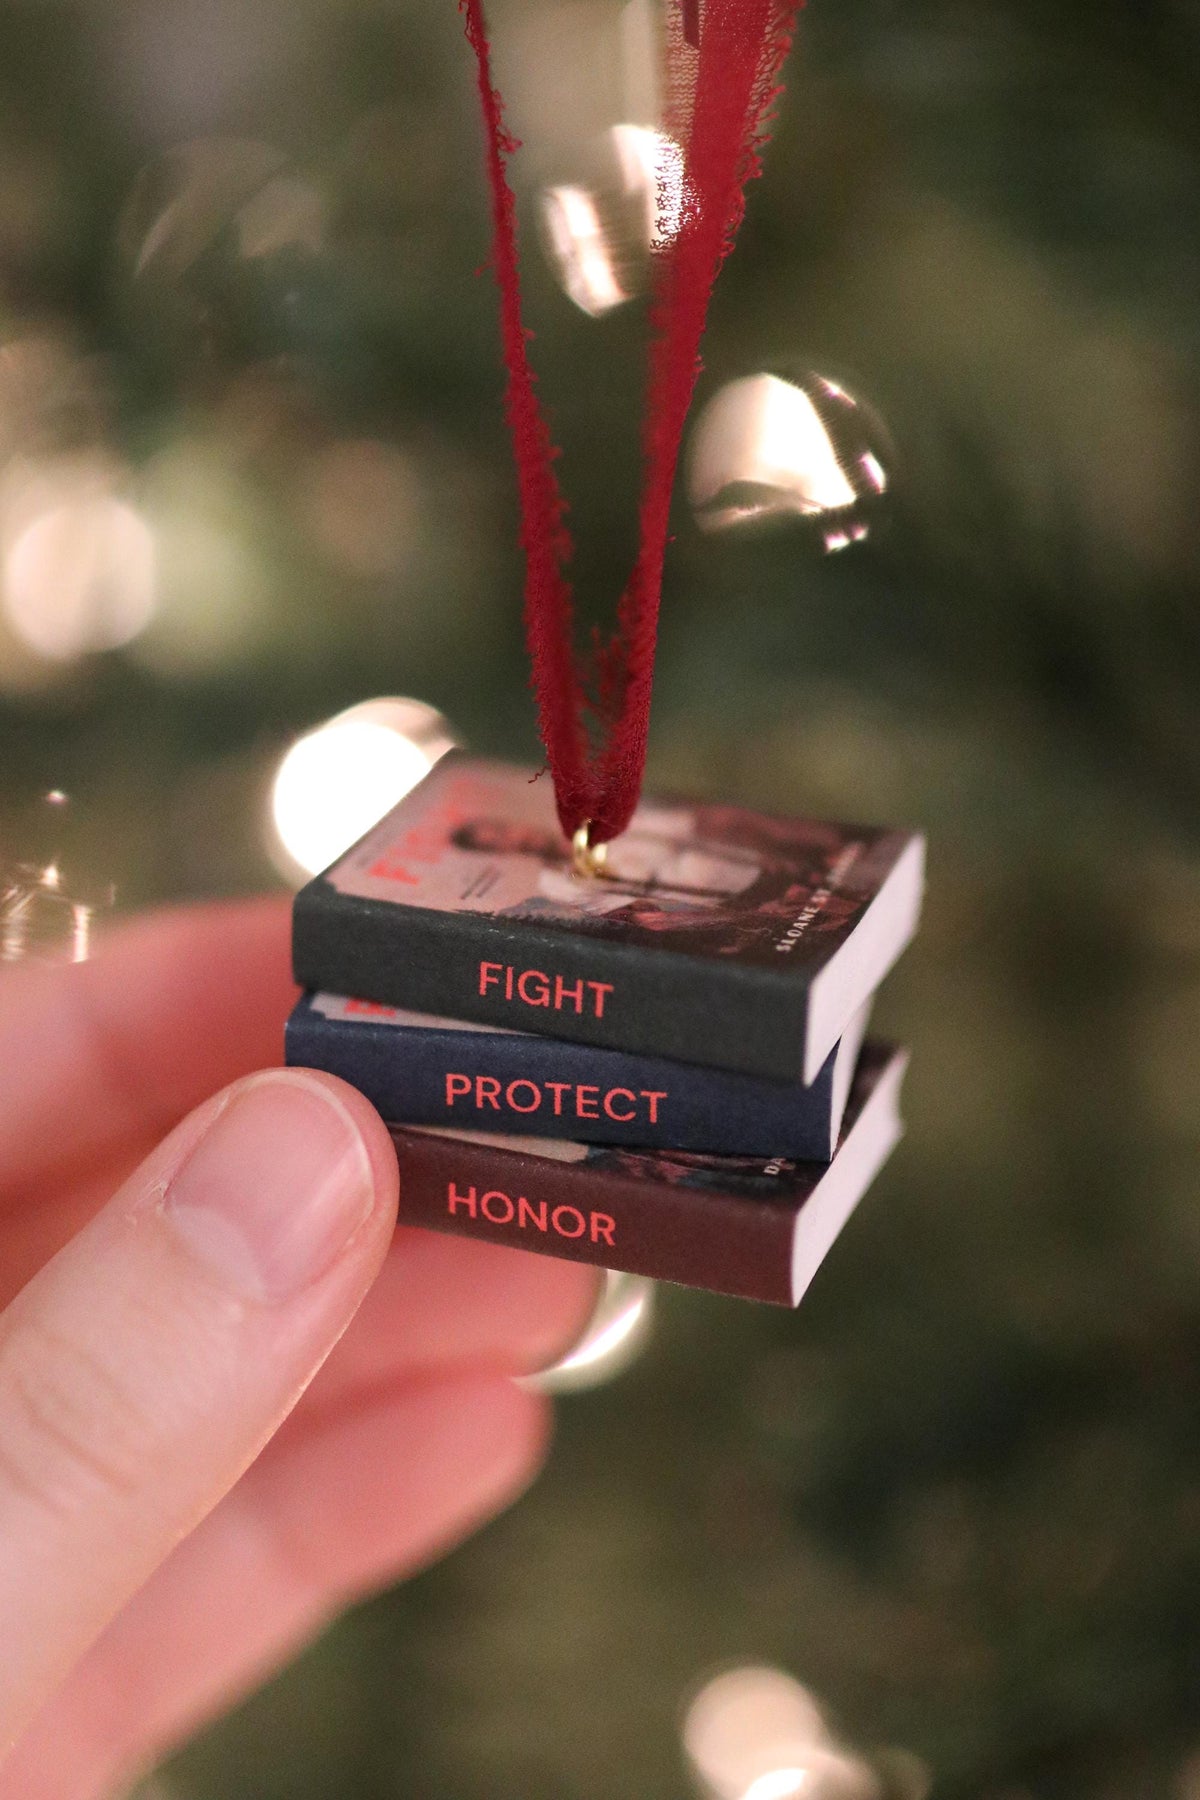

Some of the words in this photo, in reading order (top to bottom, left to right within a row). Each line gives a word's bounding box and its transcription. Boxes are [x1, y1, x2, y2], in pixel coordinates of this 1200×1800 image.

[478, 960, 615, 1019] FIGHT
[445, 1073, 668, 1124] PROTECT
[446, 1182, 617, 1247] HONOR
